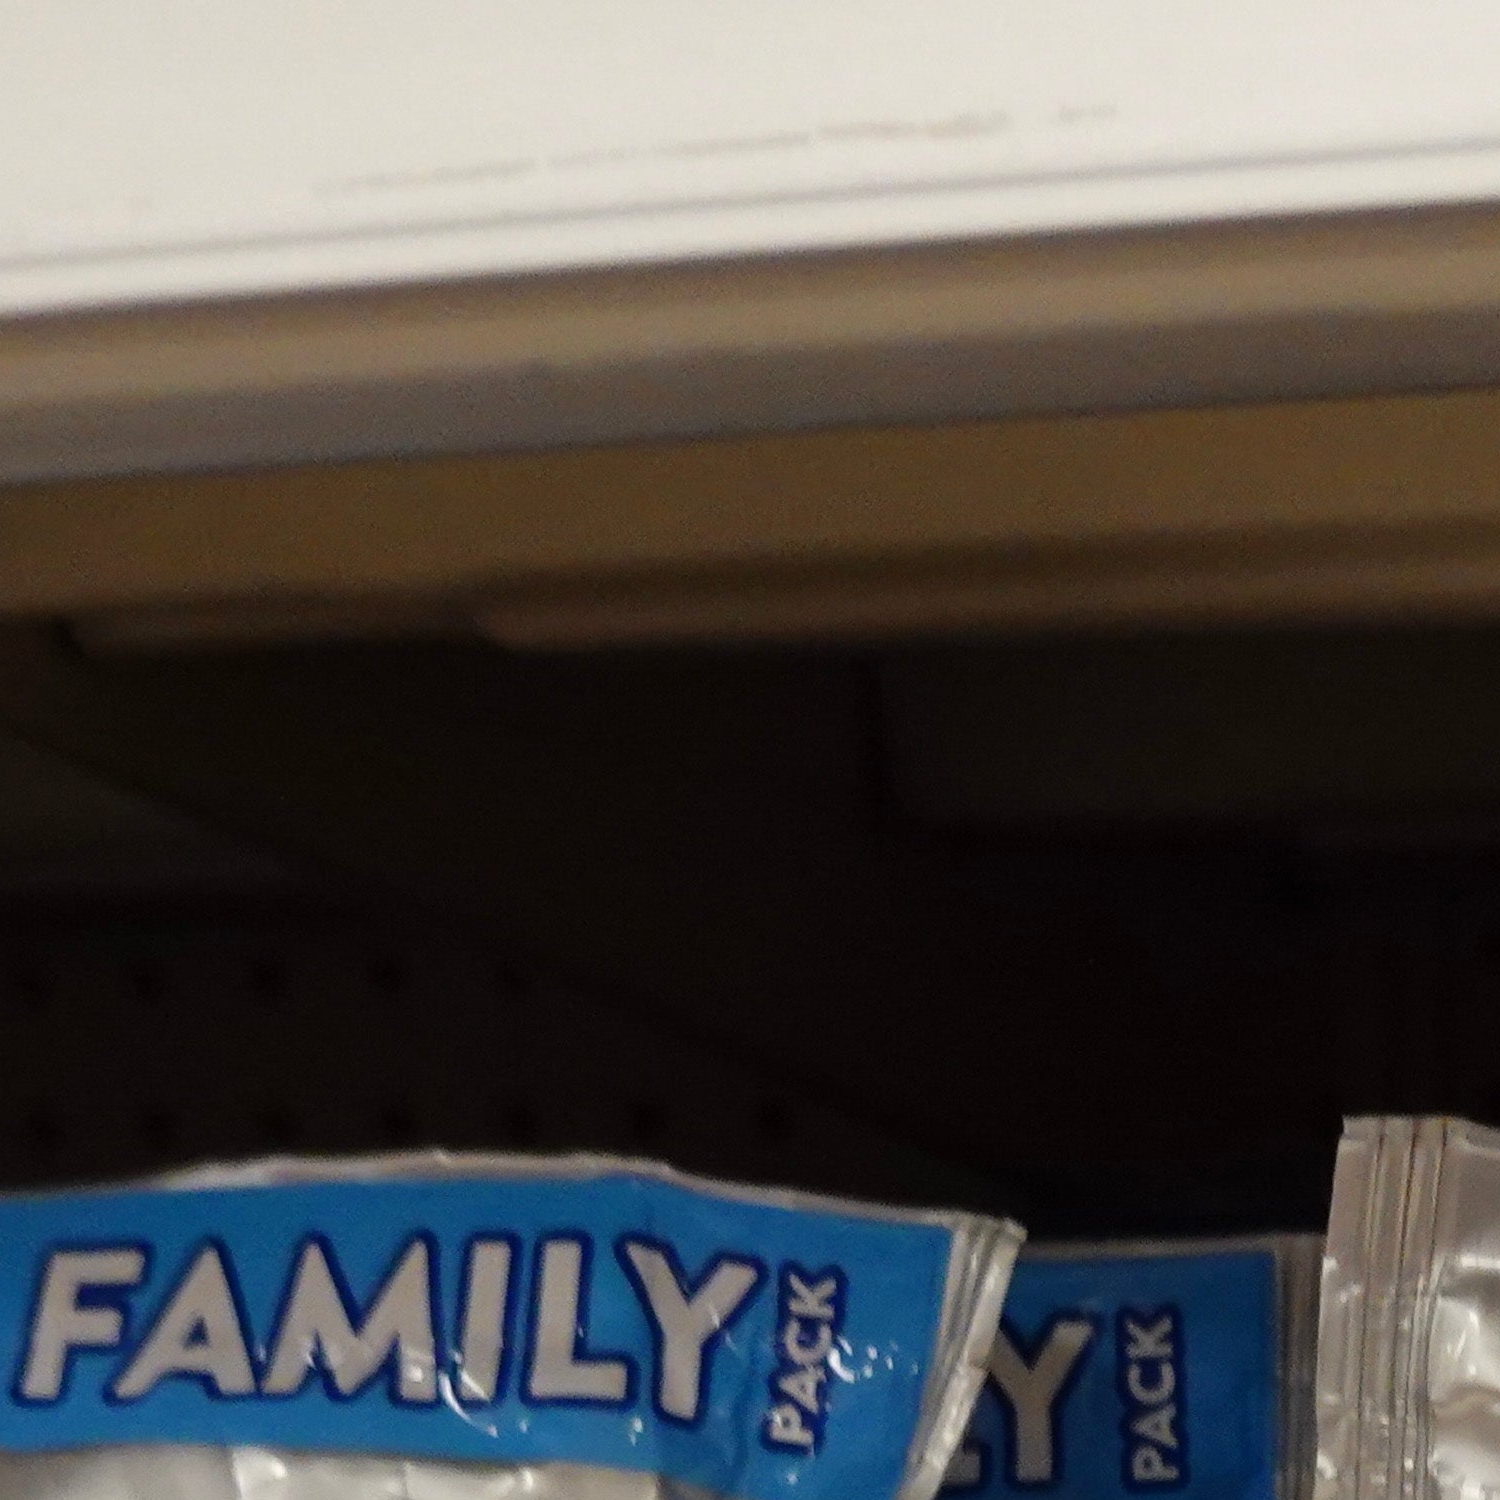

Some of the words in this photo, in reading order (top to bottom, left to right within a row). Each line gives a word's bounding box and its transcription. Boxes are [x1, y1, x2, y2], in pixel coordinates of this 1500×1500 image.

[12, 1230, 760, 1424] FAMILY
[763, 1263, 846, 1455] PACK
[1118, 1308, 1188, 1488] PACK
